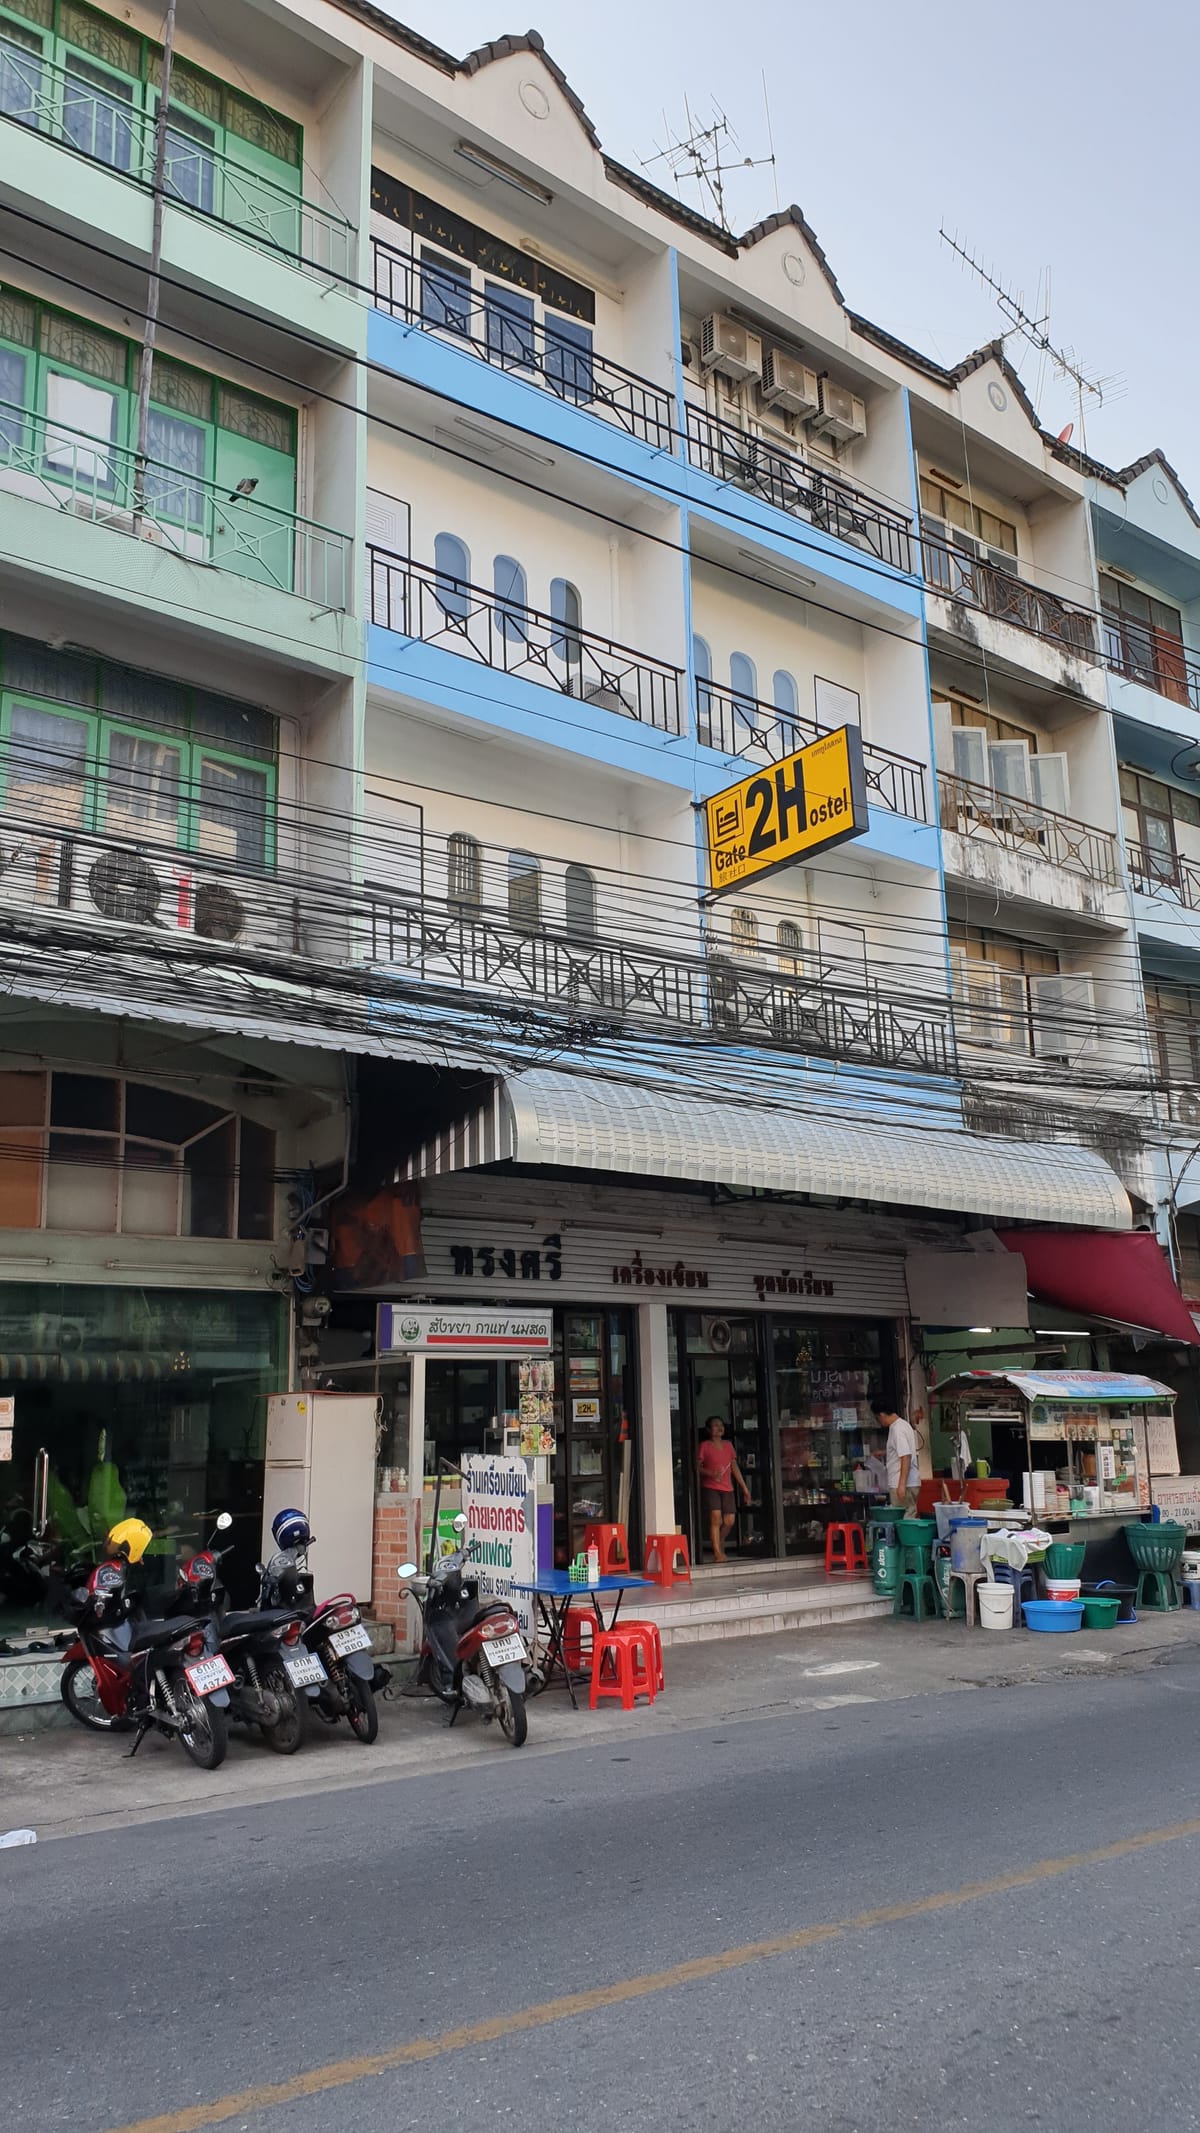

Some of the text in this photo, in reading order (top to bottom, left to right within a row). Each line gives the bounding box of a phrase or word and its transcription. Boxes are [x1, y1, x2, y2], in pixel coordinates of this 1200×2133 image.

[450, 1233, 834, 1302] ทรงศรี เครื่องเขียน ชุดนักเรียน
[428, 1317, 471, 1334] สังขยา
[475, 1320, 509, 1335] กาแฟ
[511, 1322, 547, 1336] นมสด
[466, 1460, 527, 1498] ร้านเครื่องเขียน
[468, 1499, 525, 1533] ถ่ายเอกสาร
[202, 1674, 230, 1692] 4374
